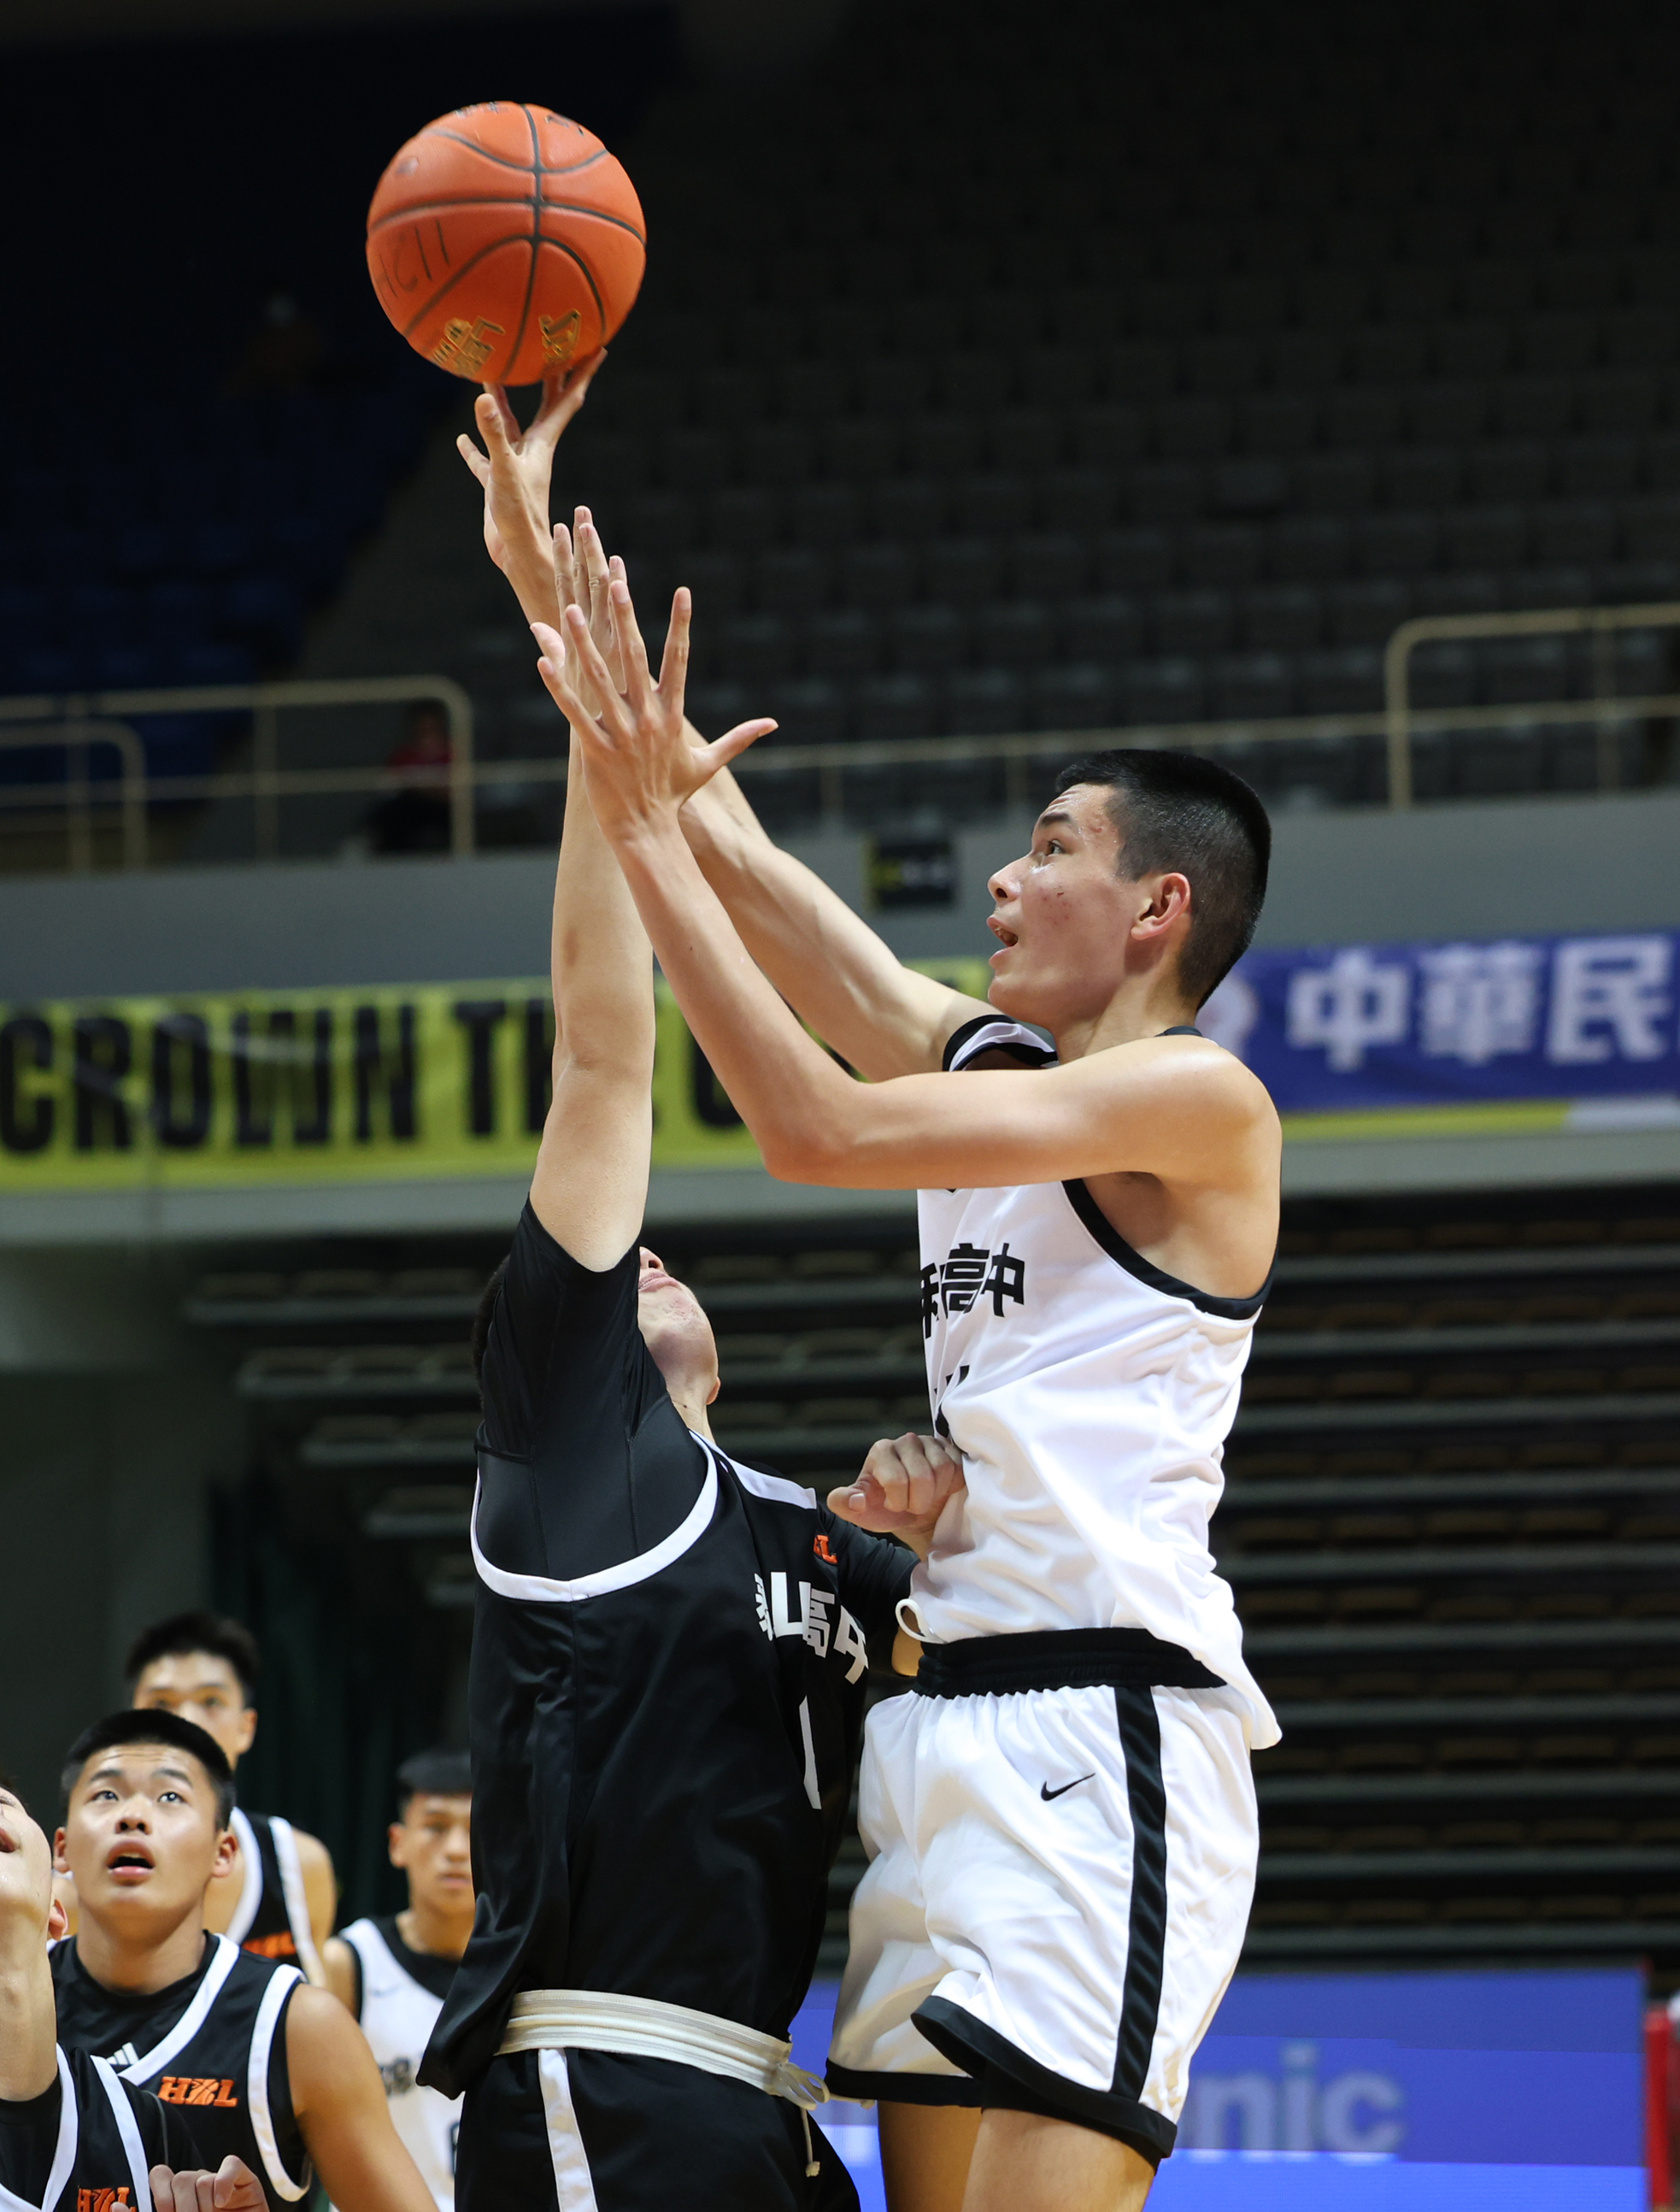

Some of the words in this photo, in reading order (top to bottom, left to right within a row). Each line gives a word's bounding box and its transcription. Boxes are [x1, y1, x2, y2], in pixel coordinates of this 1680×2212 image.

[1288, 934, 1672, 1074] 中華民
[1, 1003, 418, 1152] CROWN
